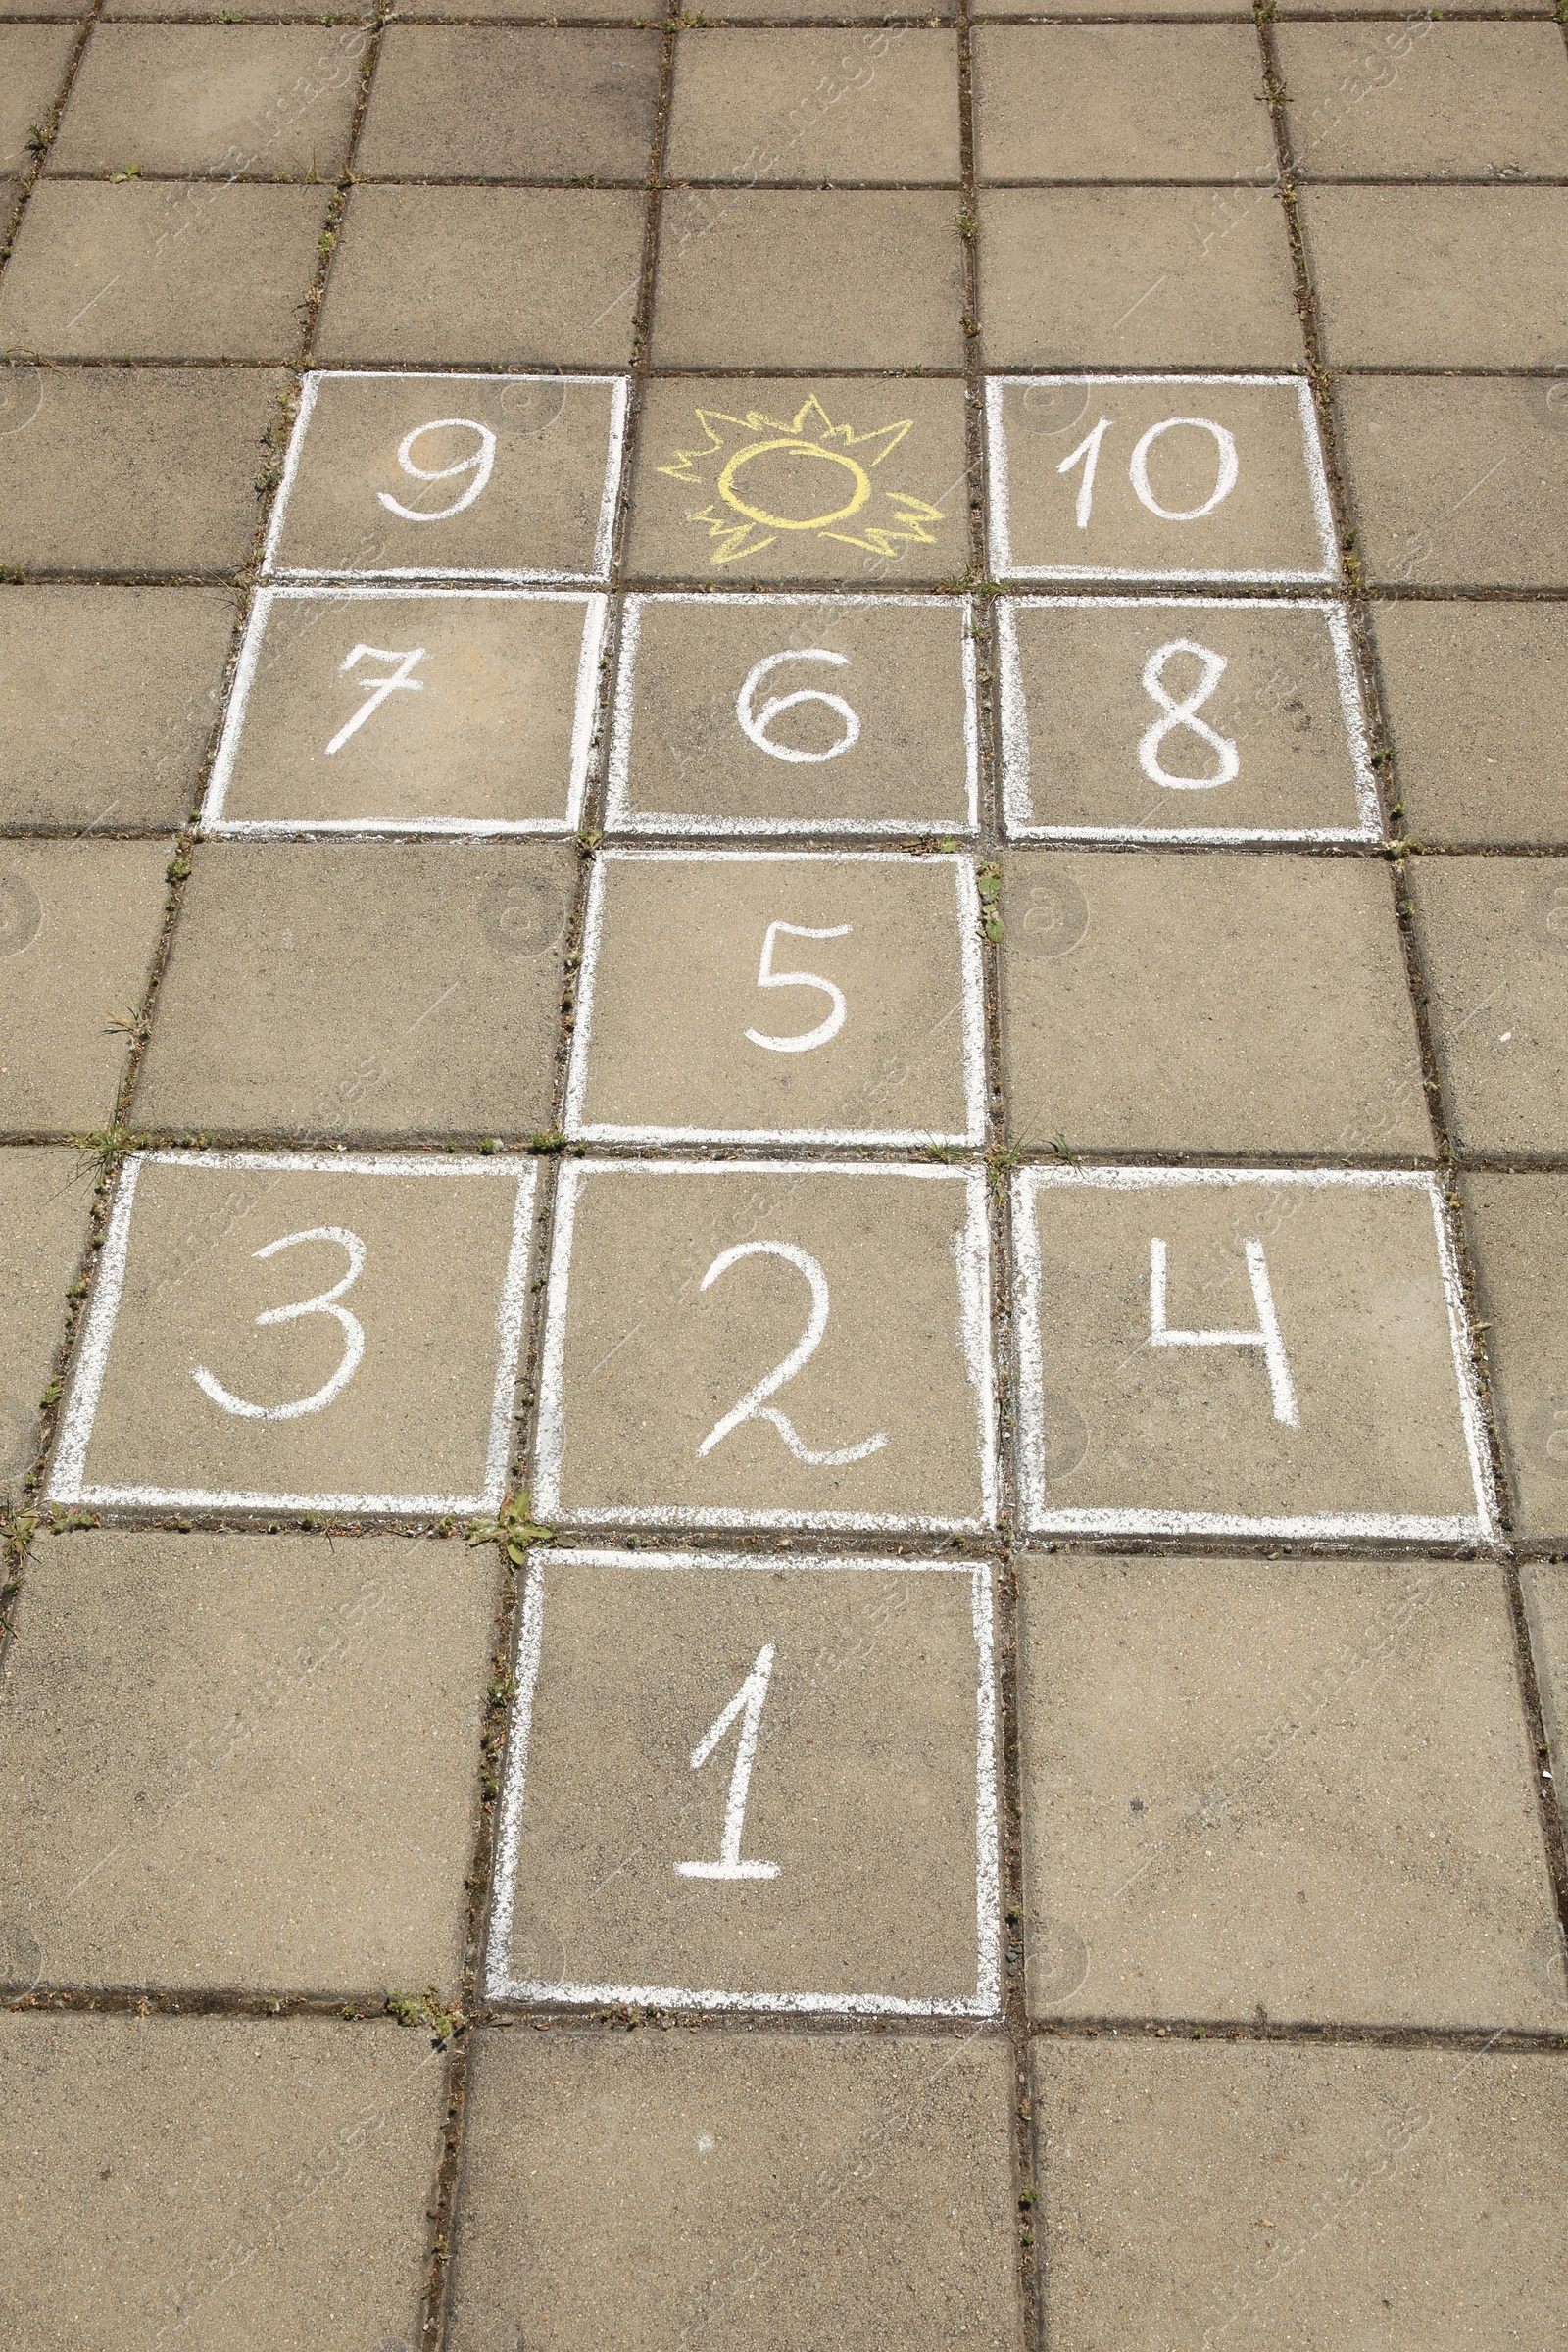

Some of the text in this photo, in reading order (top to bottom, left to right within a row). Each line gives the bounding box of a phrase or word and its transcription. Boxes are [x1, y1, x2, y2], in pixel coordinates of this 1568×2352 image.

[376, 417, 497, 522] 9
[1056, 416, 1239, 530] 10
[325, 643, 426, 755] 7
[735, 648, 862, 765] 6
[1138, 638, 1240, 790] 8
[745, 921, 853, 1055] 5
[191, 1226, 367, 1420] 3
[698, 1240, 890, 1468] 2
[1150, 1237, 1298, 1429] 4
[673, 1642, 782, 1882] 1
